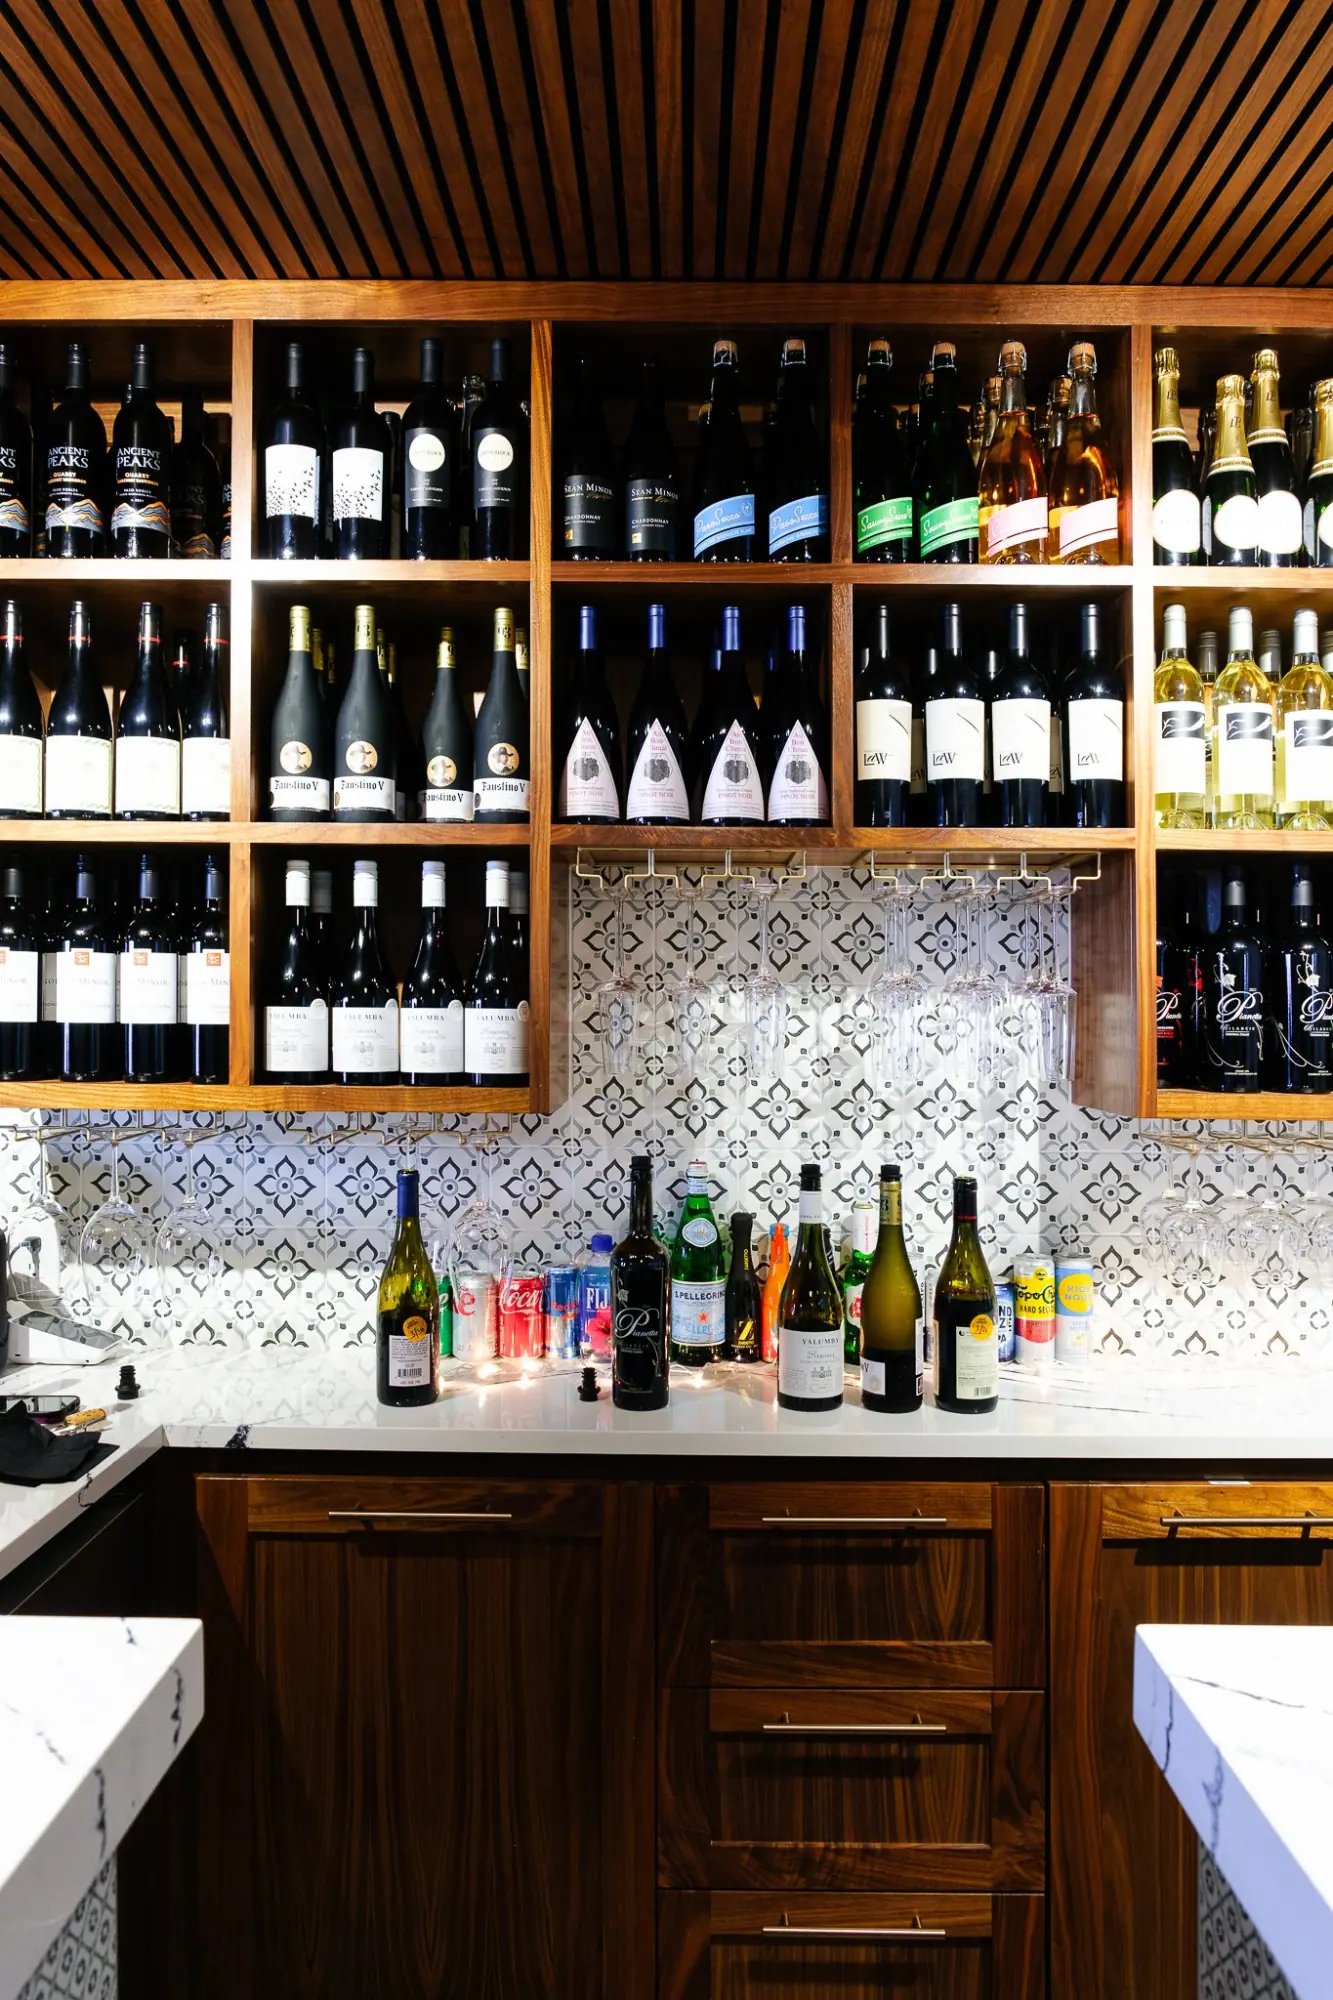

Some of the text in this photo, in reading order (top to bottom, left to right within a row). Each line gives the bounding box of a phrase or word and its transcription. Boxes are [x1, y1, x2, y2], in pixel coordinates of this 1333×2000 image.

[48, 446, 89, 457] ANCIENT
[116, 446, 161, 460] ANCIENT
[47, 455, 89, 469] PEAKS
[116, 455, 161, 471] PEAKS
[586, 483, 613, 497] MINOR
[631, 488, 652, 497] SEAN
[654, 486, 679, 501] MINOR
[564, 514, 601, 522] CHARDONNAY
[631, 517, 669, 525] CHARDONNAY
[274, 779, 319, 790] Faustino V
[341, 779, 385, 791] Faustino V
[481, 781, 526, 792] Faustino V
[457, 793, 464, 802] V
[586, 1287, 608, 1310] FIJ
[1019, 1304, 1037, 1314] HARD
